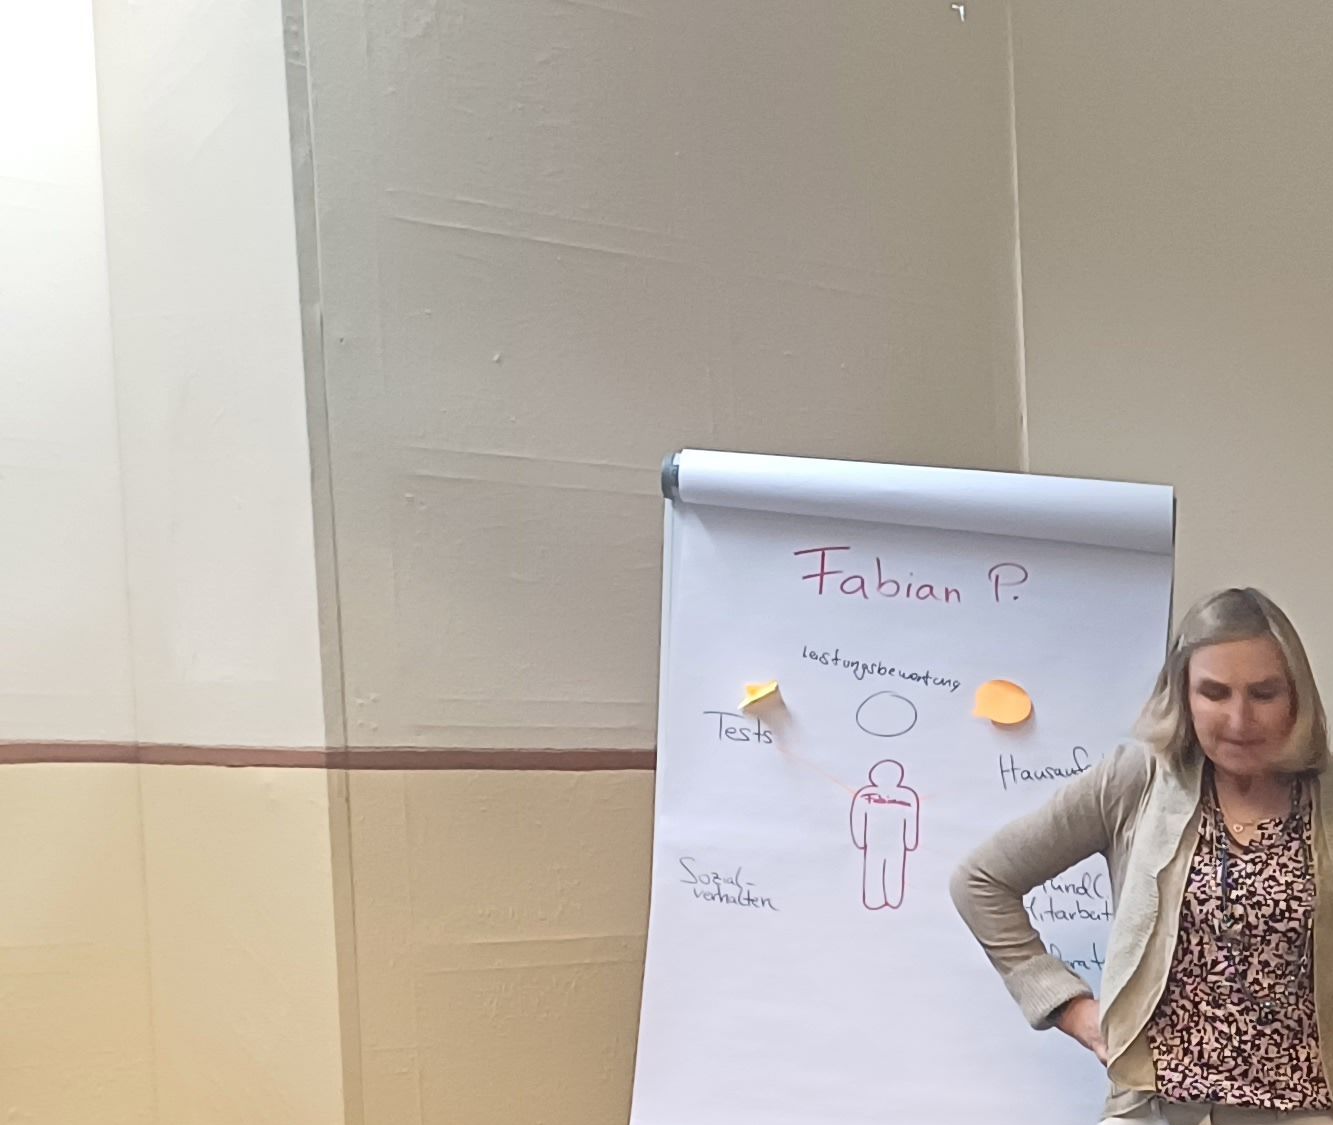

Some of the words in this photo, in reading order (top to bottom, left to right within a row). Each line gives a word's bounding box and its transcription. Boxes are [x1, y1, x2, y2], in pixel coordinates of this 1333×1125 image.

[793, 546, 962, 603] Fabian
[987, 562, 1029, 603] P.
[703, 710, 773, 744] Tests
[999, 745, 1092, 790] Hausauf
